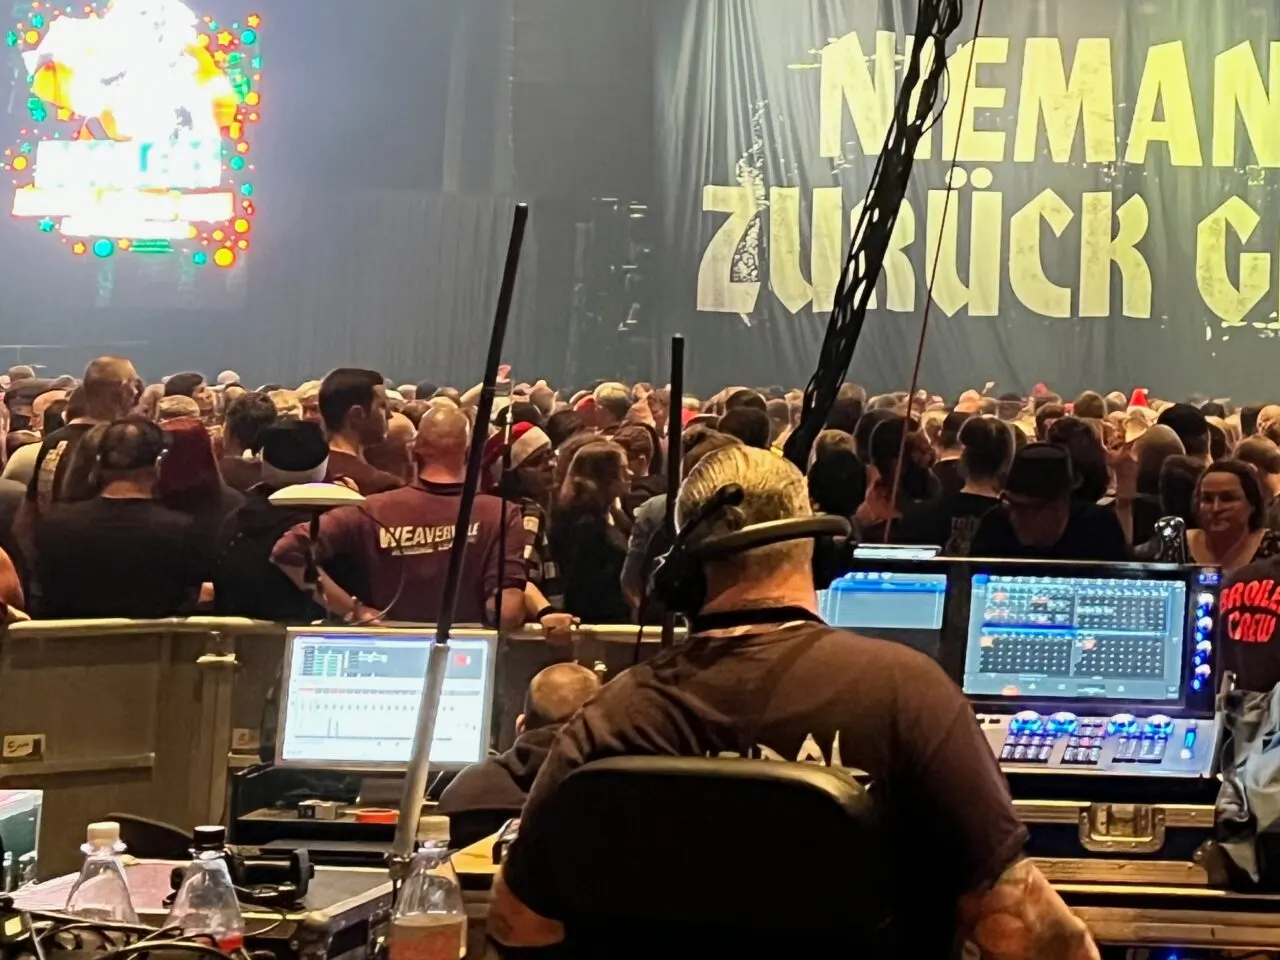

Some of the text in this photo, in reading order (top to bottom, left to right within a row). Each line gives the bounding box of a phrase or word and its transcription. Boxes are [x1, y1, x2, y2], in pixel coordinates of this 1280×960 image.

[696, 167, 1152, 319] ZURÜCK
[379, 522, 480, 549] WEAVERLE
[1228, 610, 1277, 643] CREW
